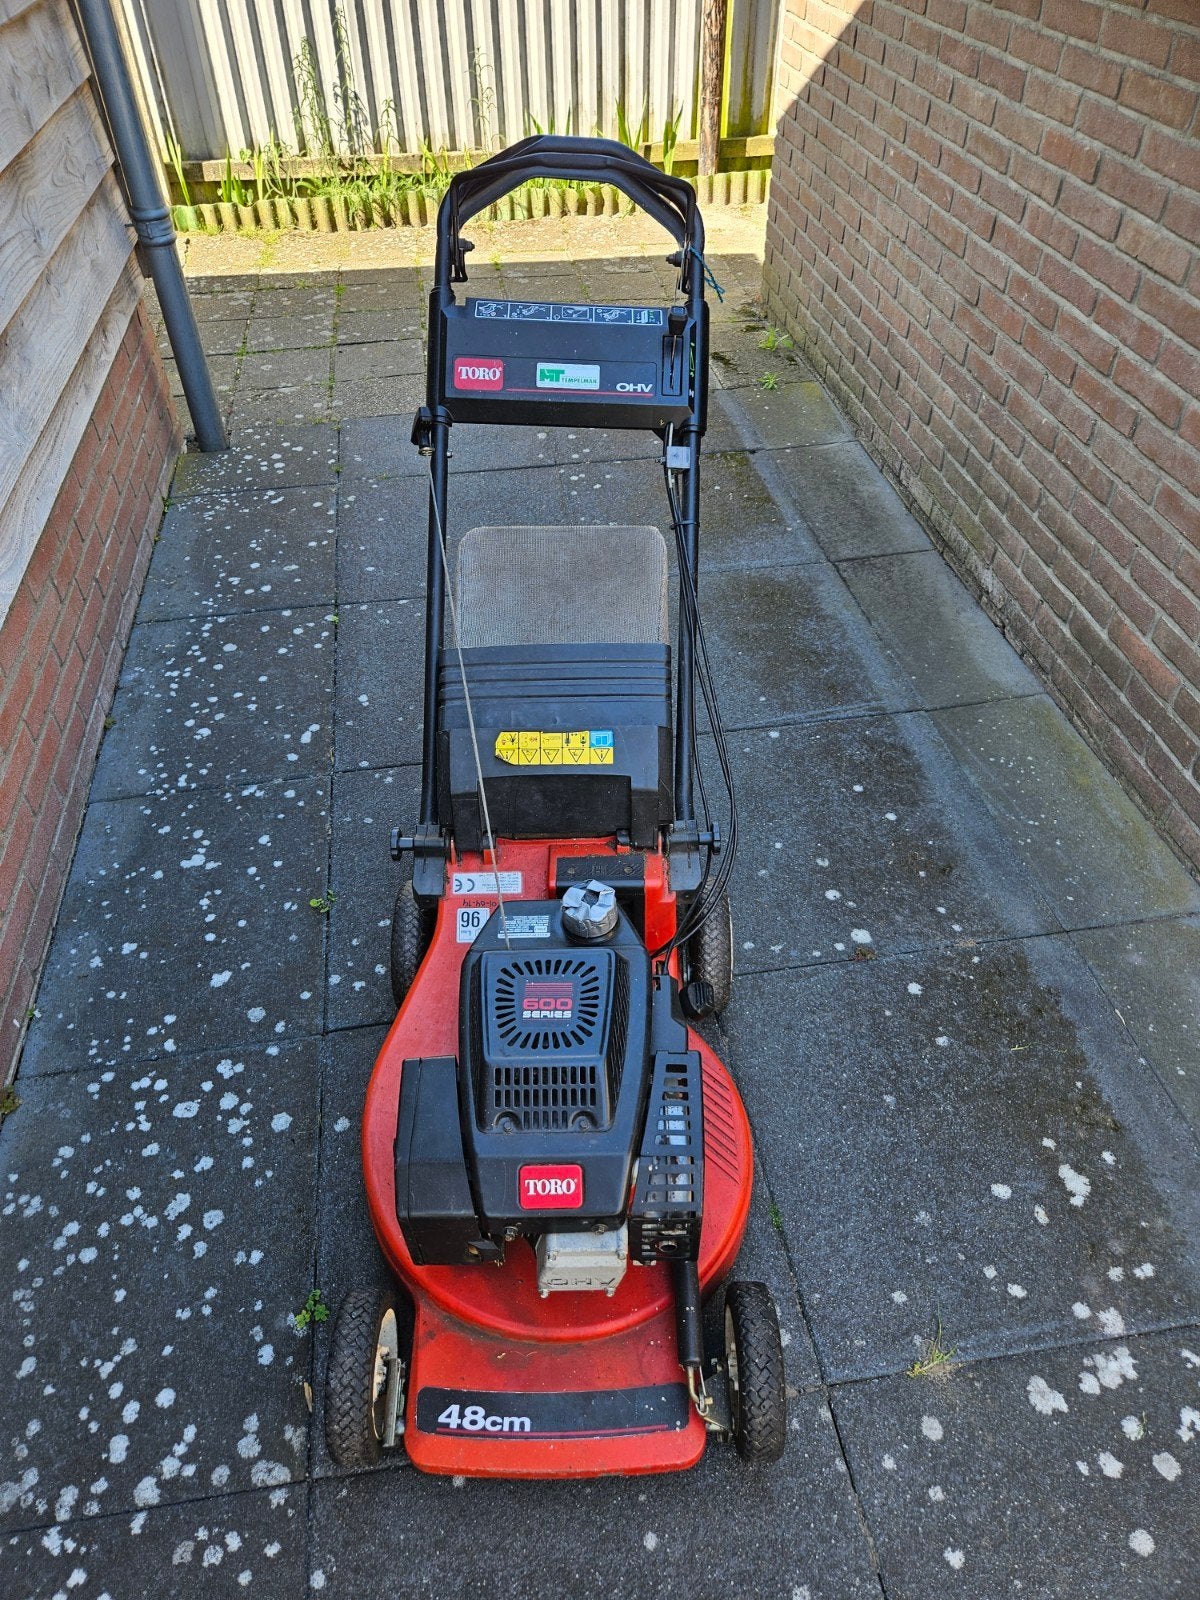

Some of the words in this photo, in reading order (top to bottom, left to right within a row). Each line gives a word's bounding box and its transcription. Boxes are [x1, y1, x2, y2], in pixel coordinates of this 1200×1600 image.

[458, 366, 500, 381] TORO
[615, 382, 653, 393] OHV
[460, 911, 480, 928] 96
[523, 997, 572, 1010] 600
[522, 1010, 572, 1019] SERIES
[525, 1179, 575, 1195] TORO
[437, 1404, 531, 1432] 48cm
